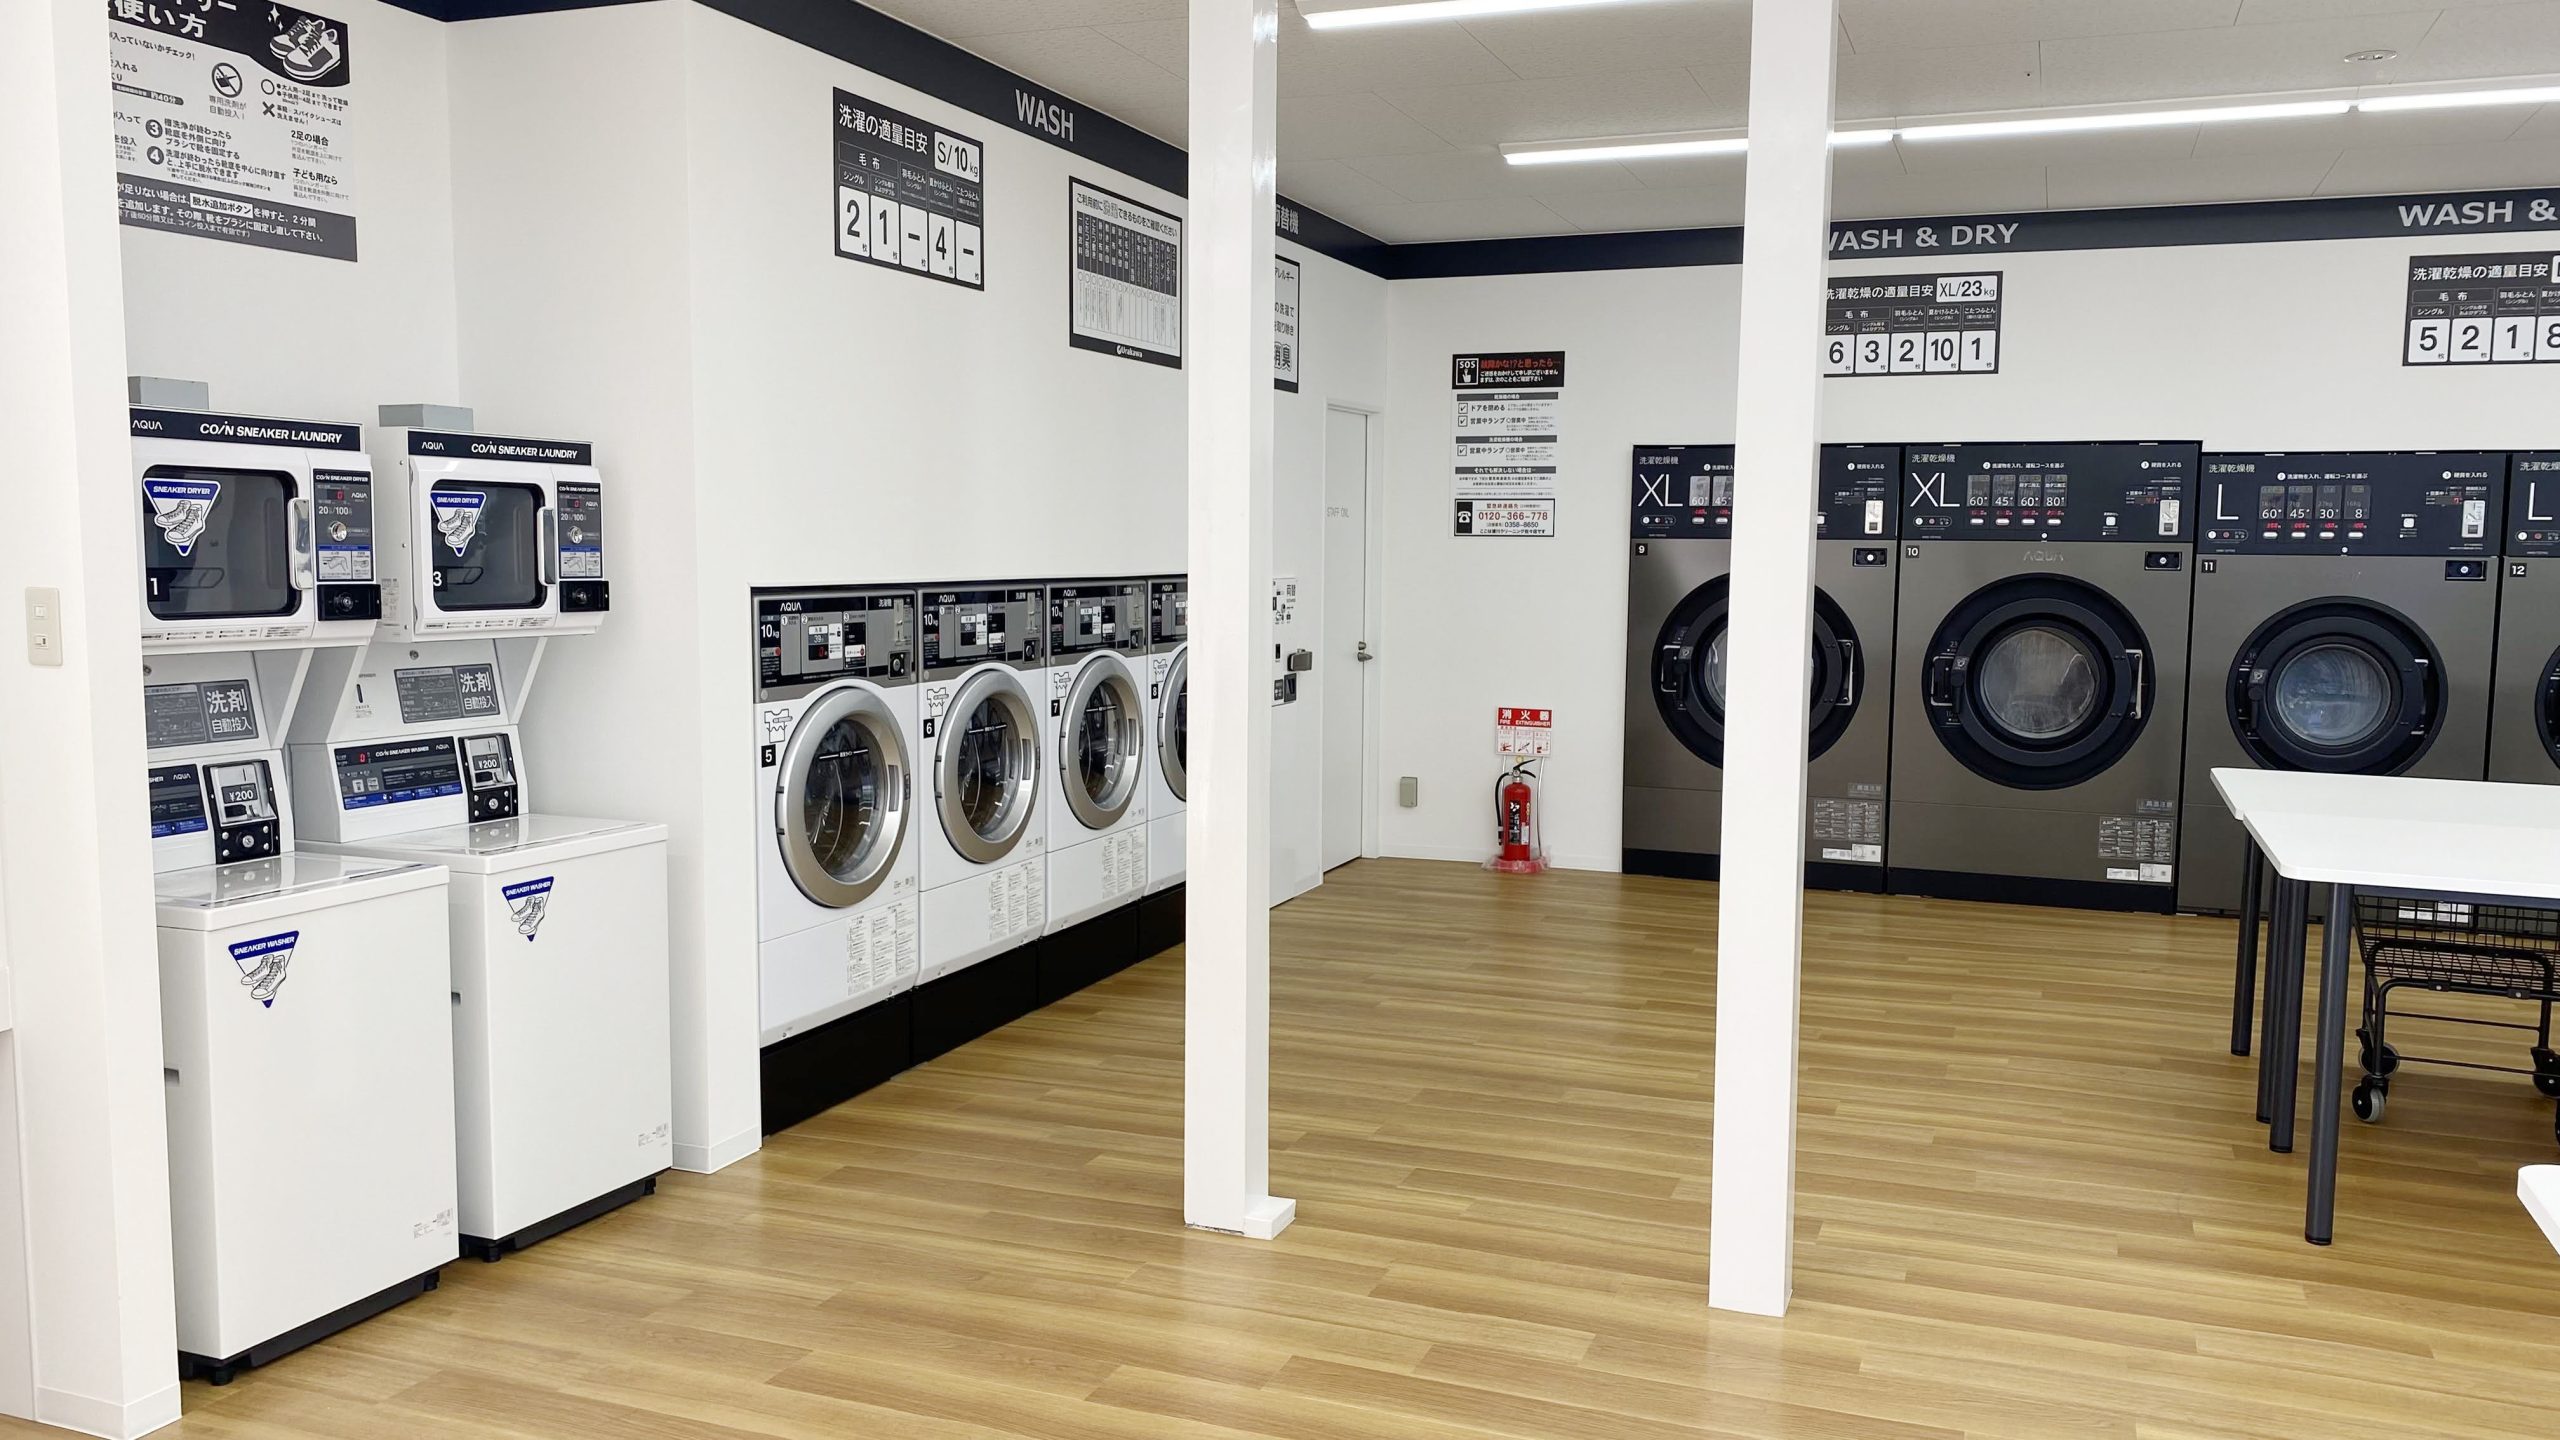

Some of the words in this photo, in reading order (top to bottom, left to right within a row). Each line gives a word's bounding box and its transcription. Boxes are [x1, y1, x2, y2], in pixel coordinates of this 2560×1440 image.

[109, 0, 207, 38] 使い方
[1015, 88, 1075, 142] WASH
[290, 129, 329, 147] 2足の場合
[838, 103, 928, 155] 洗濯の適量目安
[293, 167, 338, 185] 子ども用なら
[843, 171, 864, 185] シングル
[846, 199, 860, 238] 2
[2398, 200, 2514, 227] WASH
[2528, 198, 2559, 222] &
[879, 209, 887, 245] 1
[1915, 226, 1940, 248] &
[1951, 222, 2019, 246] DRY
[935, 226, 947, 261] 4
[2412, 263, 2549, 281] 洗濯乾燥の適量目安
[2499, 291, 2536, 299] 羽毛ふとん
[1894, 309, 1924, 317] 羽毛ふとん
[2417, 308, 2445, 316] シングル
[2419, 326, 2438, 352] 5
[2460, 324, 2480, 350] 2
[2506, 323, 2518, 349] 1
[2546, 322, 2560, 349] 8
[1828, 340, 1844, 365] 6
[1864, 339, 1880, 363] 3
[1898, 338, 1915, 362] 2
[1930, 337, 1954, 362] 10
[1970, 337, 1981, 361] 1
[1459, 360, 1476, 369] SOS
[131, 419, 163, 431] AQUA
[236, 426, 289, 440] SNEAKER
[291, 429, 343, 444] LAUNDRY
[421, 441, 445, 451] AQUA
[498, 445, 538, 457] SNEAKER
[539, 448, 578, 460] LAUNDRY
[1911, 453, 1956, 463] 洗濯乾燥機
[2208, 463, 2256, 474] 洗濯乾燥機
[152, 485, 186, 495] SNEAKER
[186, 486, 211, 496] DRYER
[351, 491, 368, 499] AQUA
[1637, 473, 1684, 507] XL
[1909, 472, 1961, 508] XL
[436, 496, 461, 504] SNEAKER
[2216, 483, 2240, 521] L
[2527, 482, 2553, 521] L
[1478, 511, 1548, 521] 0120-366-778
[1638, 545, 1645, 554] 9
[1906, 547, 1919, 556] 10
[2023, 550, 2064, 562] AQUA
[2203, 561, 2214, 571] 11
[2511, 565, 2525, 575] 12
[149, 577, 160, 595] 1
[433, 571, 442, 586] 3
[938, 594, 956, 603] AQUA
[1062, 589, 1077, 597] AQUA
[780, 601, 802, 612] AQUA
[760, 623, 780, 639] 10kg
[460, 671, 492, 693] 洗剤
[1152, 686, 1158, 697] 8
[206, 688, 248, 714] 洗剤
[463, 695, 496, 710] 自動投入
[1053, 702, 1059, 714] 7
[1501, 708, 1550, 721] 消火器
[211, 716, 252, 734] 自動投入
[926, 722, 933, 735] 6
[478, 759, 497, 769] ¥200
[765, 749, 773, 763] 5
[173, 773, 192, 781] AQUA
[229, 789, 254, 802] ¥200
[234, 942, 267, 956] SNEAKER
[266, 936, 295, 948] WASHER
